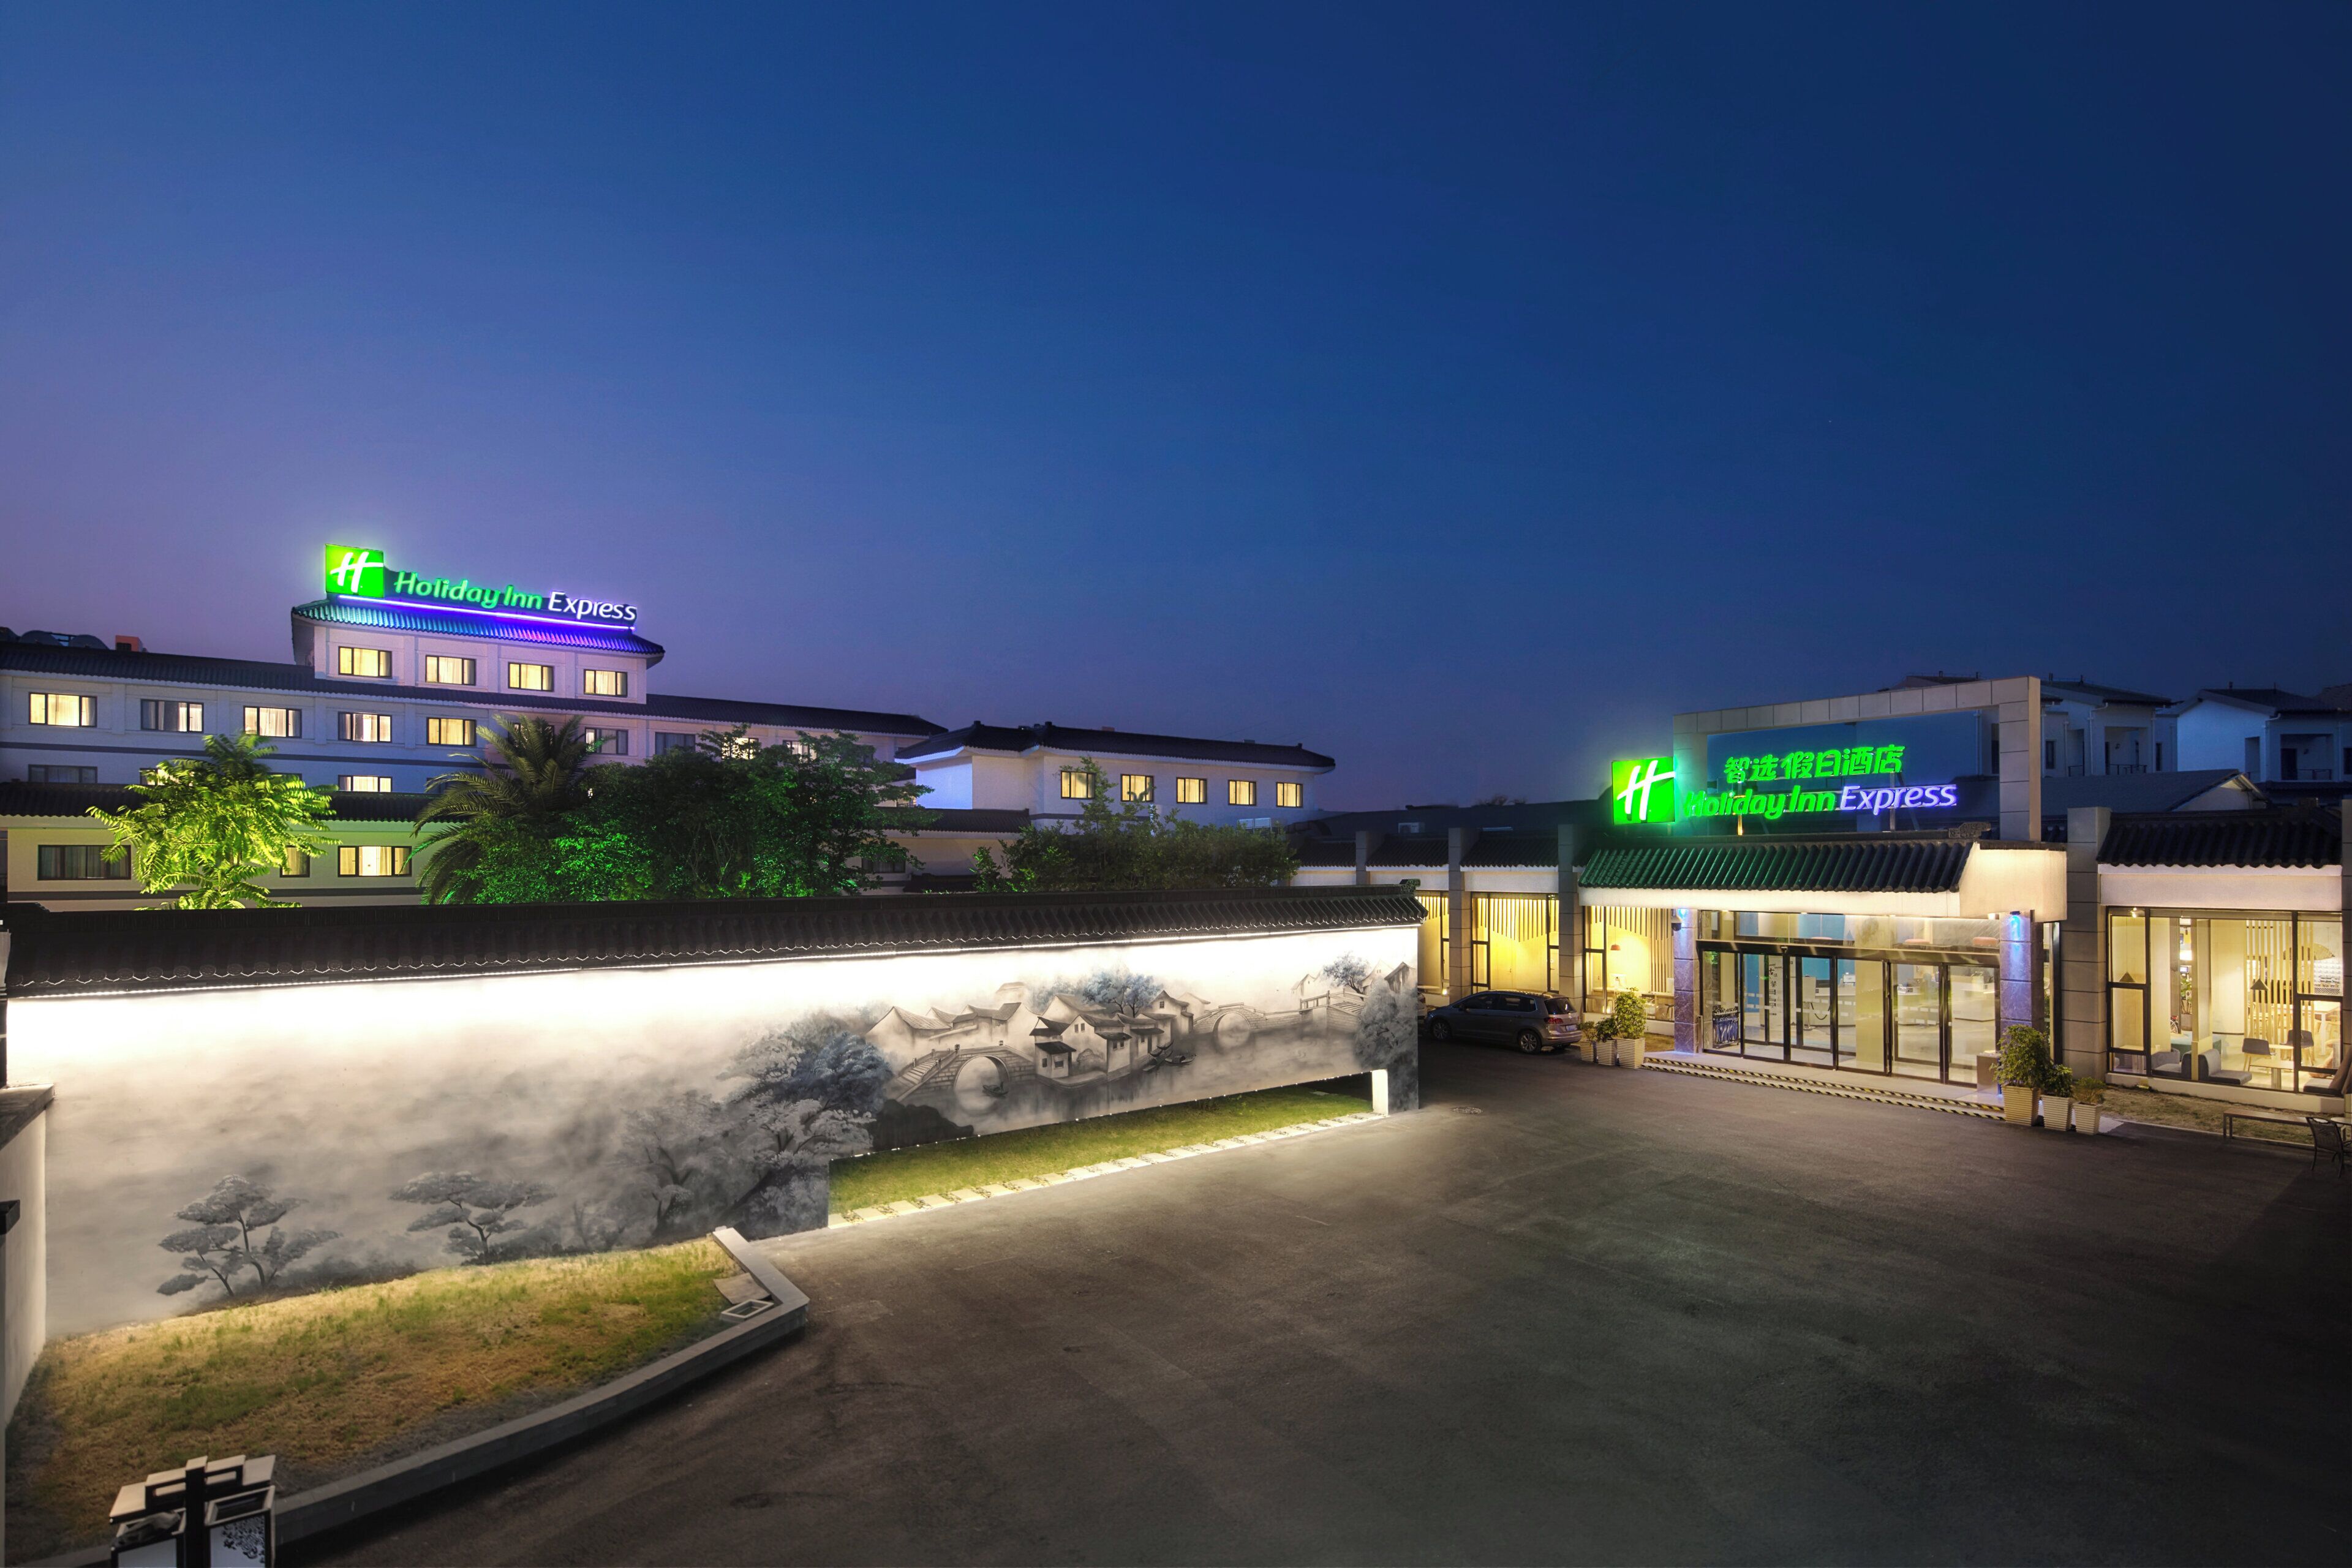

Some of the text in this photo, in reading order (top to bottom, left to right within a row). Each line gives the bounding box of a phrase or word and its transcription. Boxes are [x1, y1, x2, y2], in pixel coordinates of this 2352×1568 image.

[394, 570, 636, 621] Holiday Inn Express
[1724, 744, 1905, 783] 智选假日酒店
[1684, 784, 1958, 820] Holiday Inn Express
